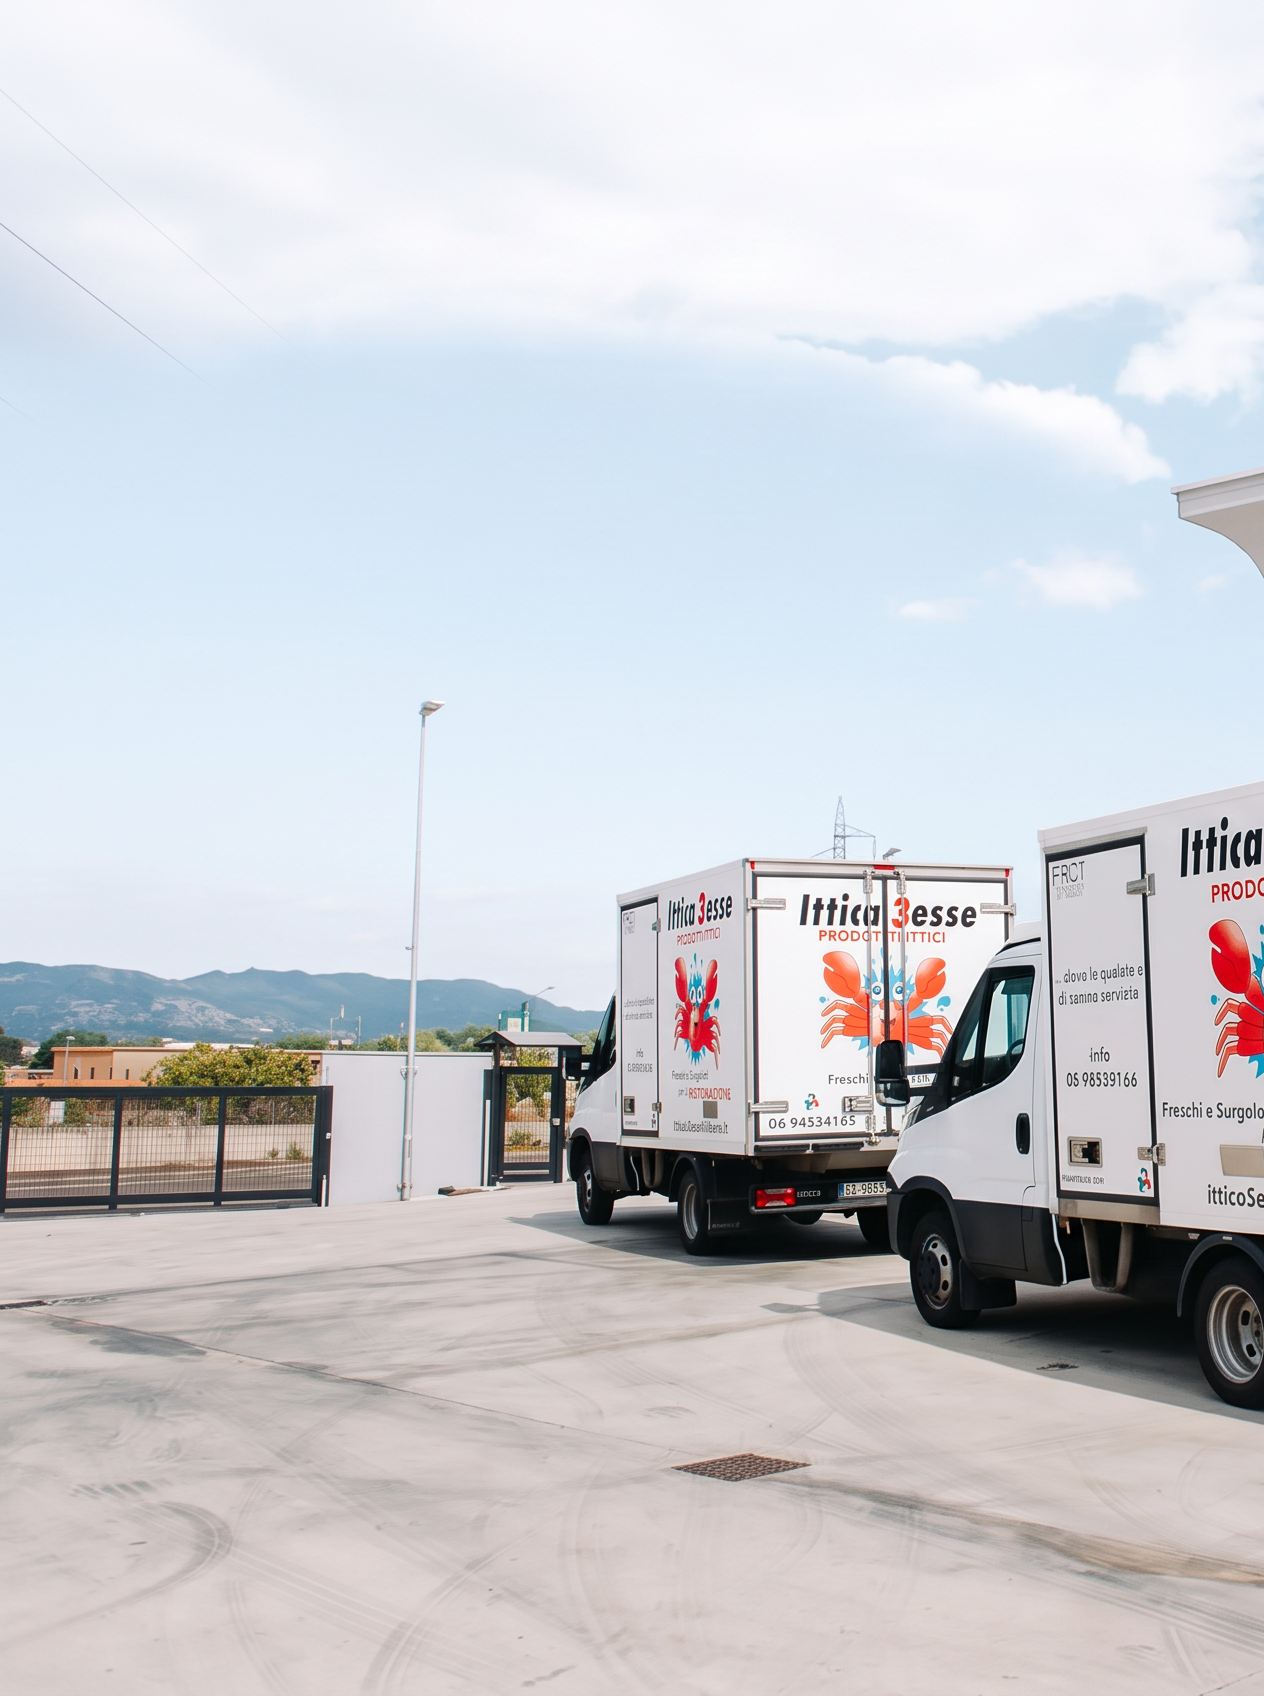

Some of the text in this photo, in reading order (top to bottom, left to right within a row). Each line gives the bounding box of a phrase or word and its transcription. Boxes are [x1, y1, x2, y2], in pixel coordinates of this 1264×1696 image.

[1180, 816, 1263, 878] Ittica
[667, 896, 695, 931] Ittica
[799, 893, 880, 927] Ittica
[906, 931, 945, 943] ITTICI
[1089, 966, 1098, 981] le
[1058, 991, 1067, 1006] di
[828, 1073, 869, 1085] Freschi
[1162, 1101, 1203, 1118] Freschi
[1206, 1106, 1213, 1118] e
[768, 1115, 856, 1130] 06 94534165
